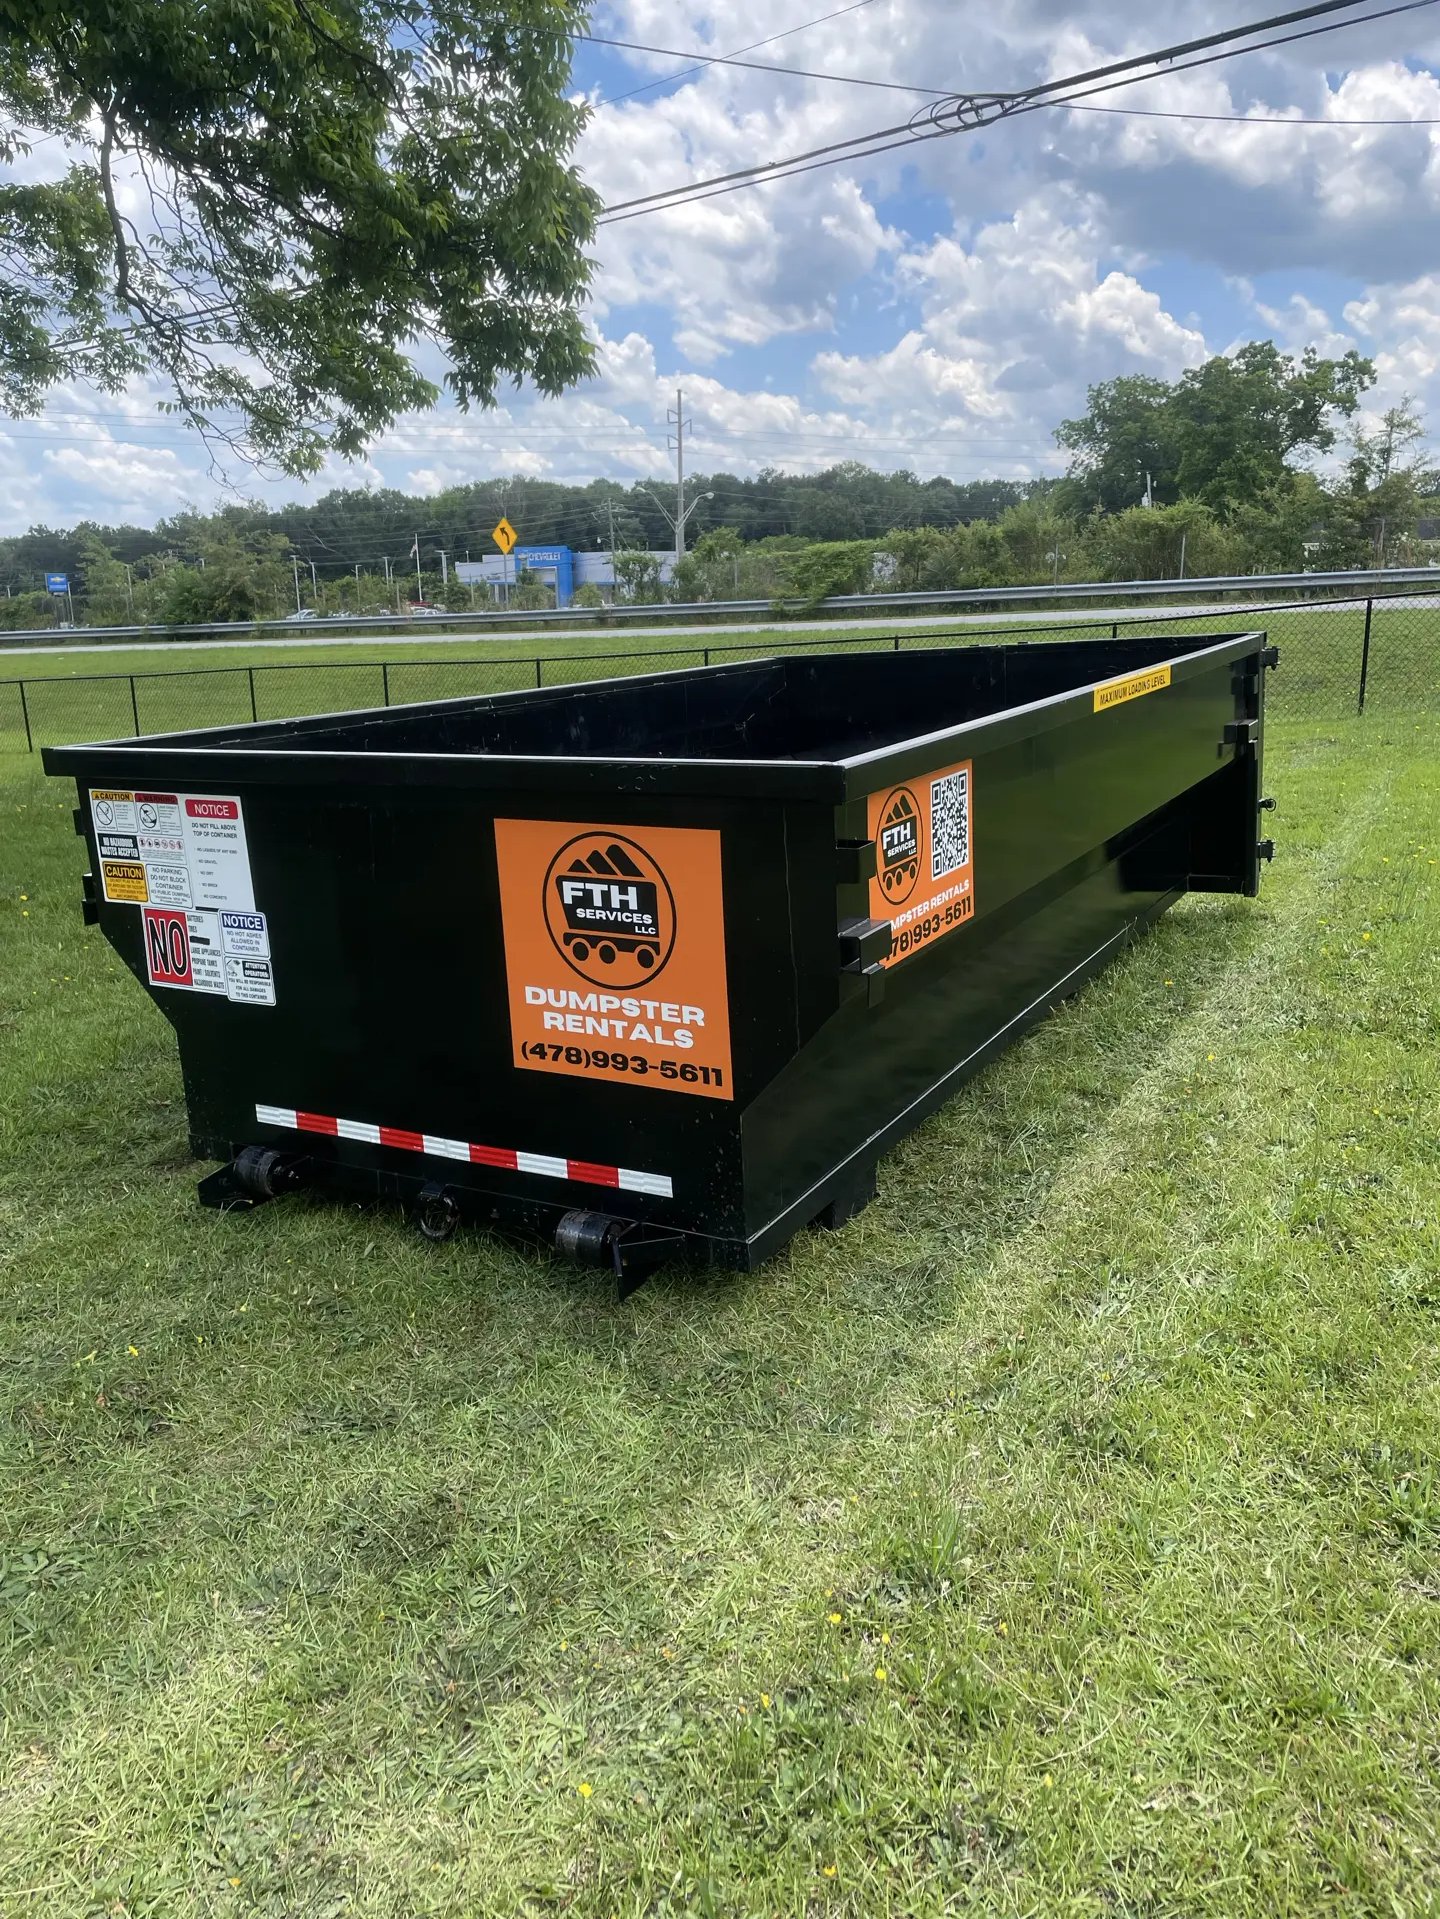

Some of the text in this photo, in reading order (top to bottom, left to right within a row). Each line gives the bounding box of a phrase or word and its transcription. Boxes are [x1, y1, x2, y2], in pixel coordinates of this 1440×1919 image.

[528, 552, 561, 561] CHEVROLET
[1100, 675, 1165, 705] MAXIMUM LOADING LEVEL
[194, 804, 229, 816] NOTICE
[882, 822, 911, 850] FTH
[888, 839, 915, 857] SERVICES
[106, 866, 142, 878] CAUTION
[562, 881, 638, 910] FTH
[890, 879, 969, 931] MPSTER RENTALS
[223, 915, 262, 929] NOTICE
[576, 908, 653, 925] SERVICES
[635, 925, 656, 935] LLC
[886, 896, 971, 961] 78)993-5611
[147, 917, 188, 977] NO
[524, 986, 705, 1026] DUMPSTER
[543, 1011, 694, 1049] RENTALS
[521, 1041, 723, 1087] (478)993-5611
